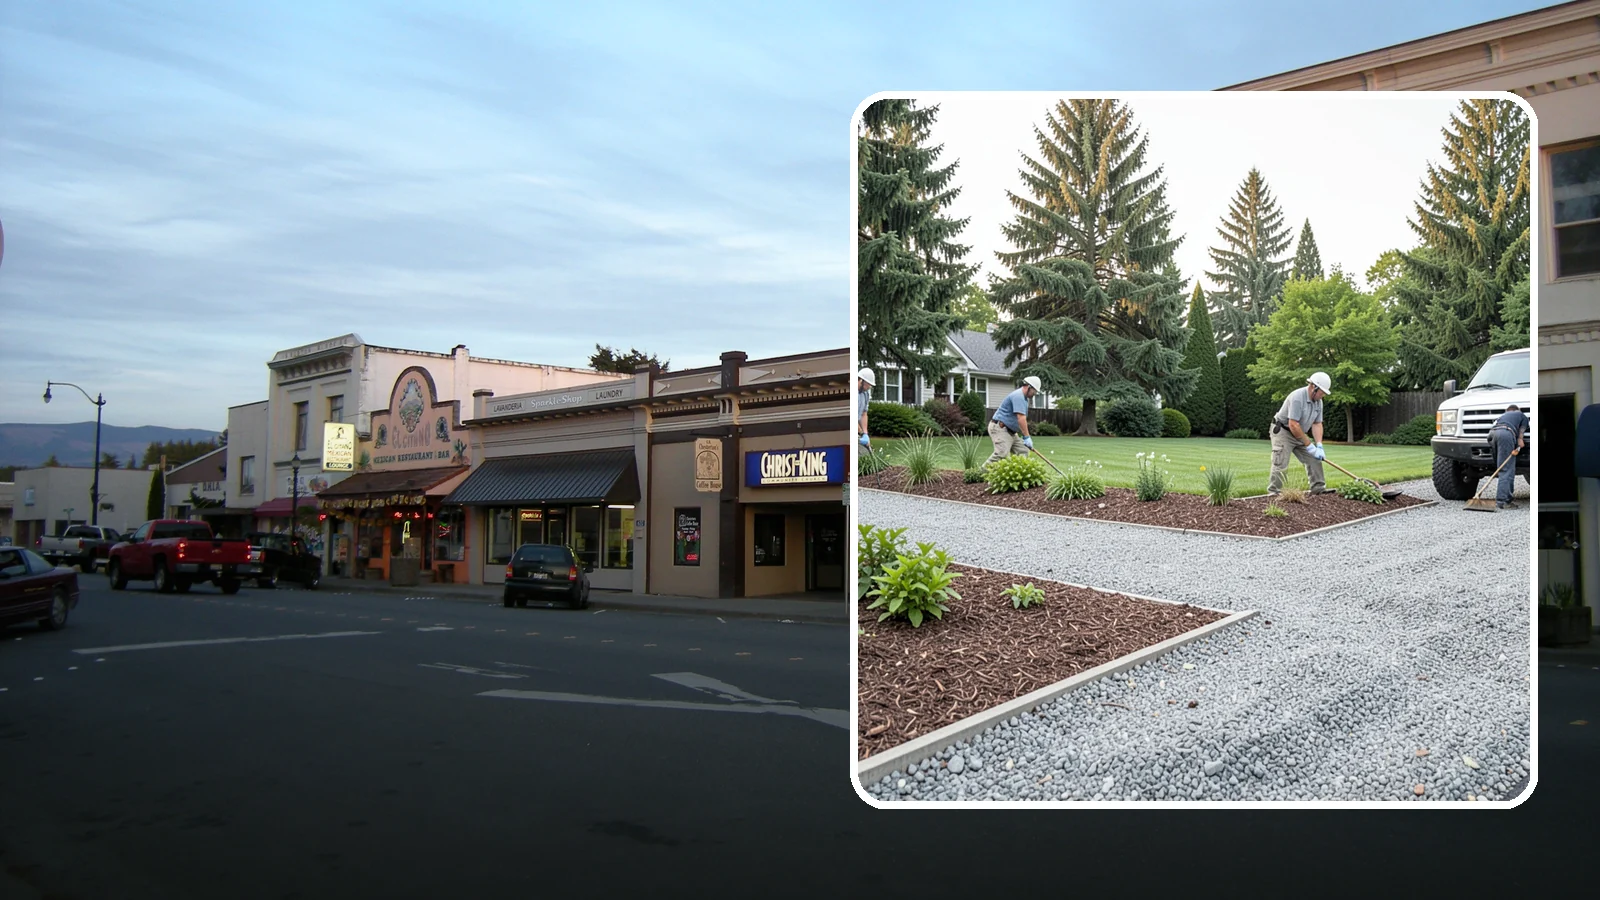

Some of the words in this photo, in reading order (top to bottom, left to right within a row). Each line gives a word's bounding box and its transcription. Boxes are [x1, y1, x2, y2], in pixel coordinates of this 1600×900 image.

[562, 394, 582, 404] Shop
[595, 389, 623, 400] LAUNDRY
[493, 402, 522, 412] LAVANDERIA
[374, 456, 396, 464] MEXICAN
[397, 451, 433, 462] RESTAURANT
[437, 450, 450, 459] BAR
[761, 452, 797, 478] CHRIST
[799, 450, 827, 476] KING
